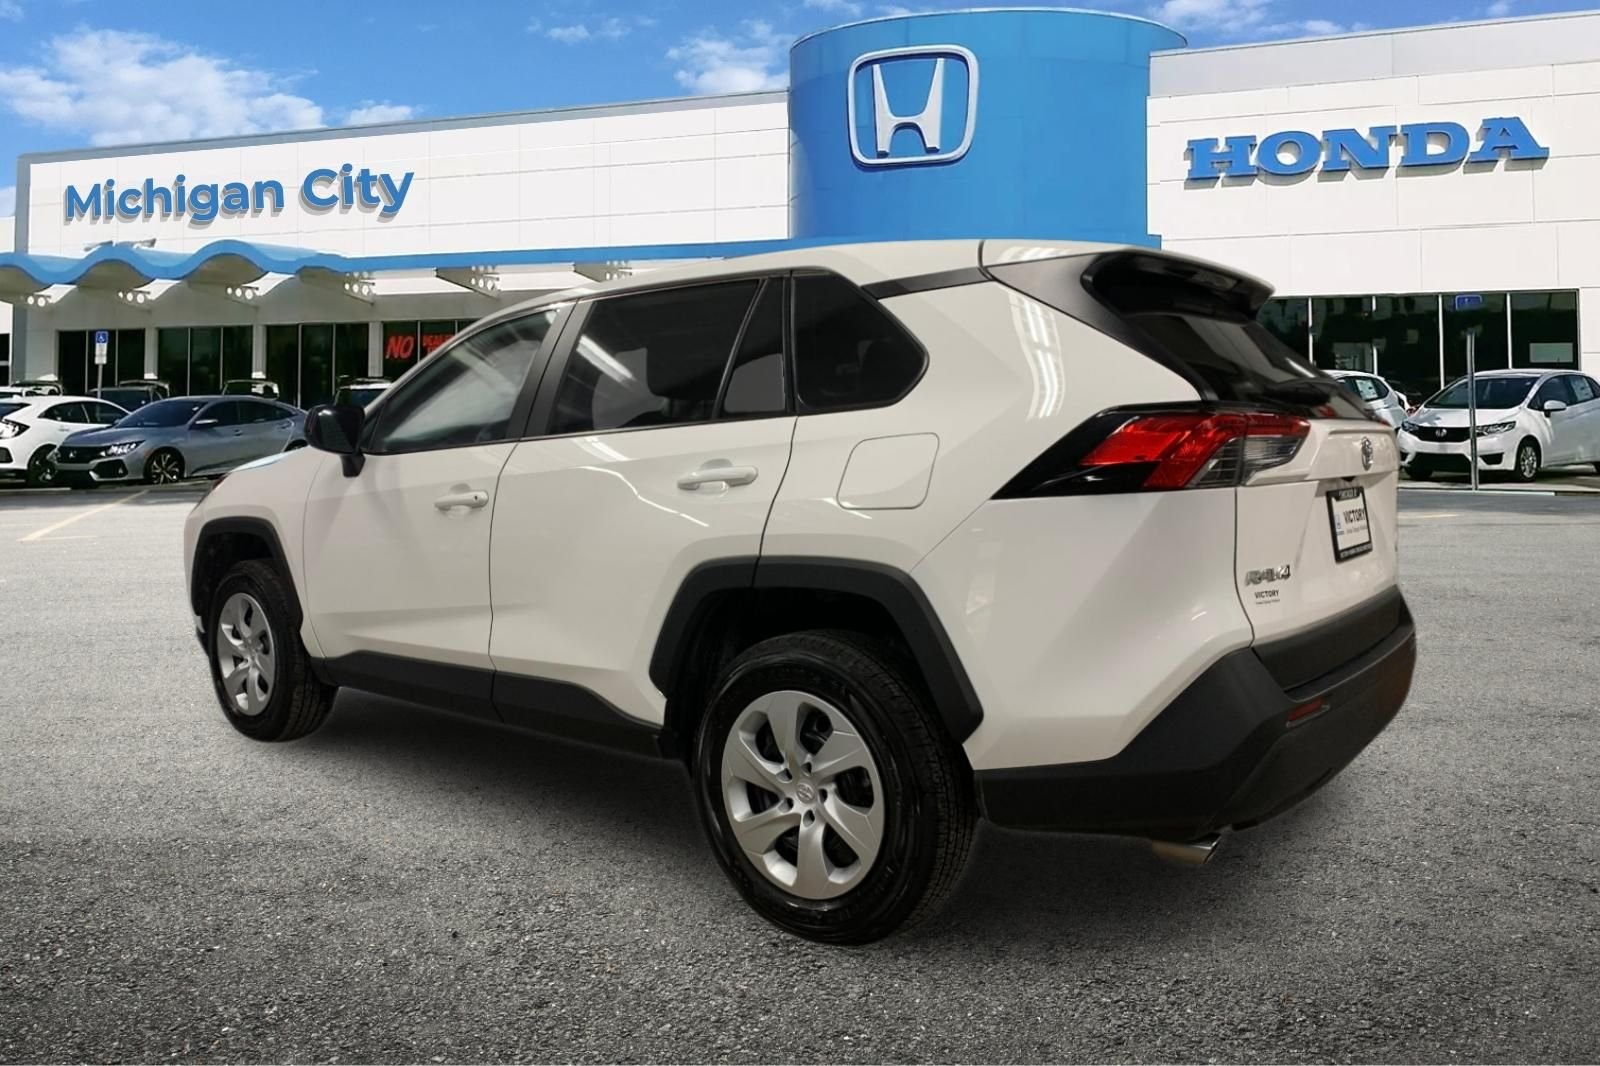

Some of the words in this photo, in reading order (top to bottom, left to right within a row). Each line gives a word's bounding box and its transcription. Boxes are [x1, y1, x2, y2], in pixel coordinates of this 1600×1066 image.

[1185, 116, 1550, 187] HONDA
[65, 173, 285, 224] Michigan
[302, 163, 415, 215] City
[384, 335, 415, 359] NO
[1343, 508, 1366, 524] VICTORY
[1254, 589, 1279, 599] VICTORY
